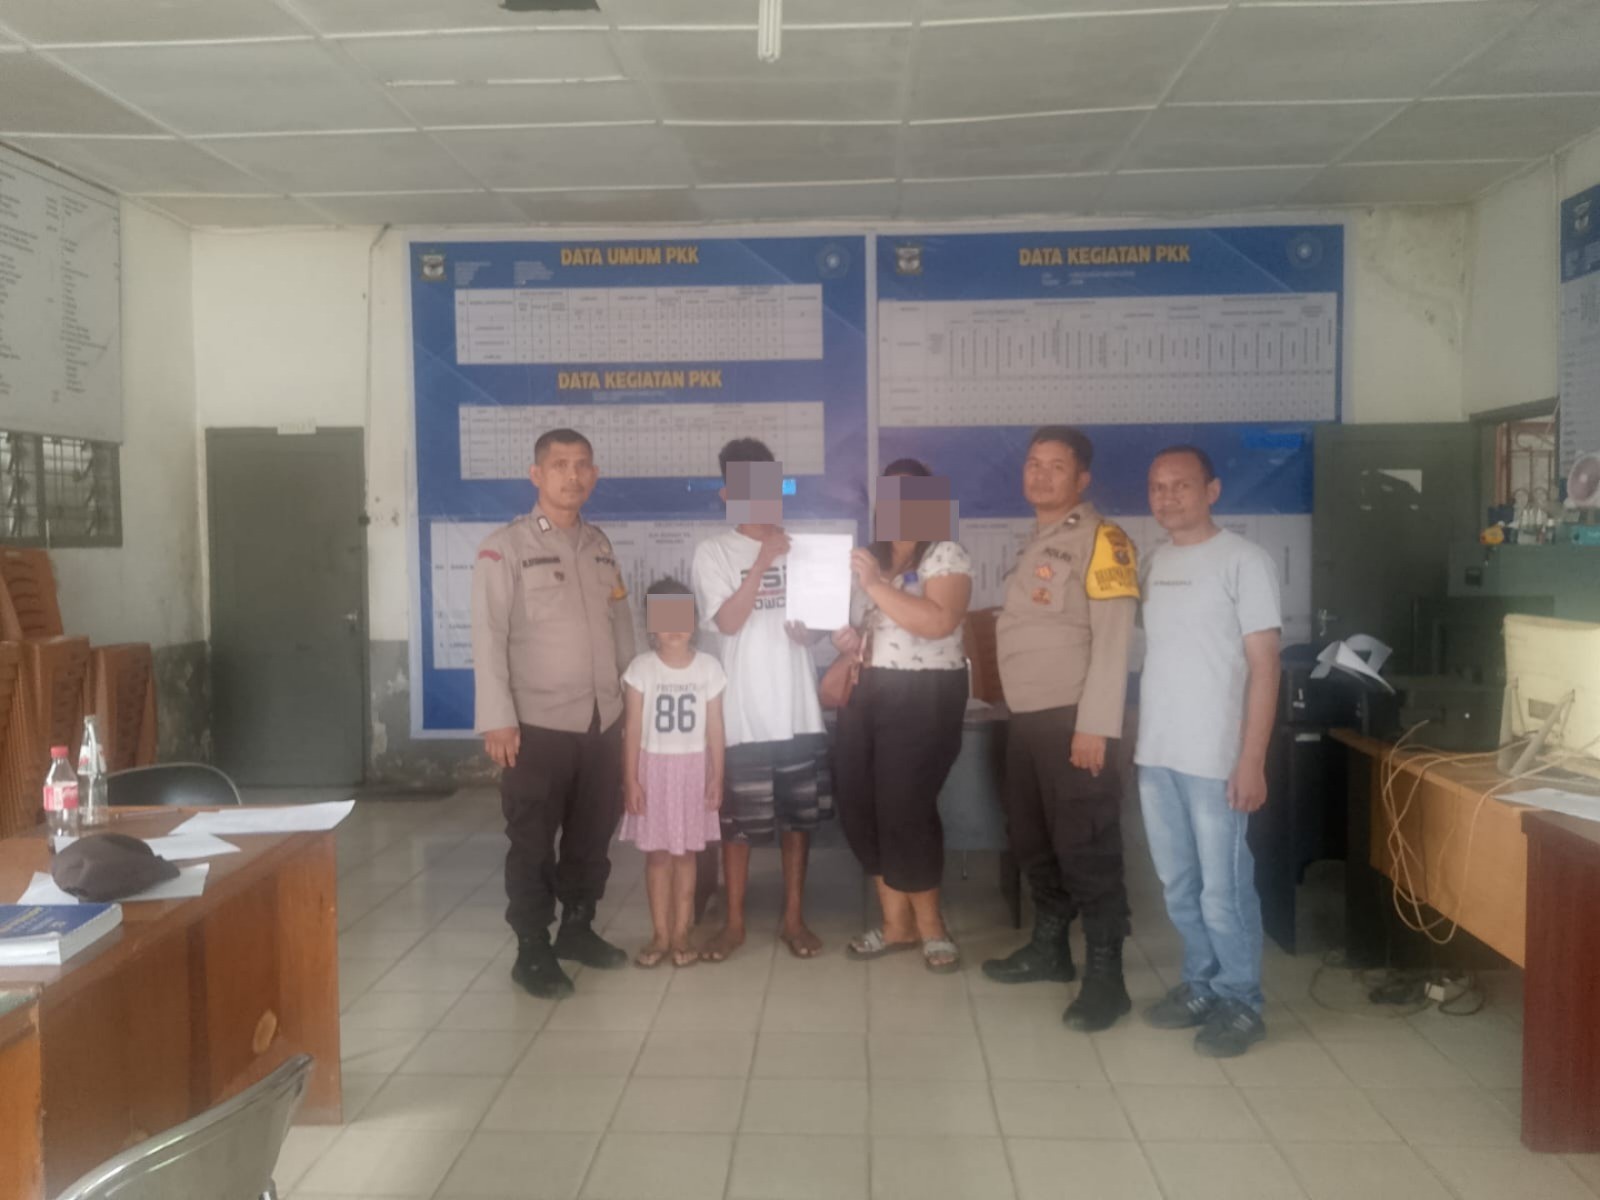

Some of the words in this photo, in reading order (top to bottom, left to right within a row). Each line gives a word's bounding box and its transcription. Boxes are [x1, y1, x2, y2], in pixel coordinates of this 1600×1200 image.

[560, 248, 603, 267] DATA
[607, 246, 661, 266] UMUM
[665, 245, 698, 264] PKK
[1019, 248, 1062, 266] DATA
[1067, 246, 1151, 265] KEGIATAN
[1156, 245, 1191, 263] PKK
[559, 372, 600, 390] DATA
[605, 371, 684, 389] KEGIATAN
[689, 370, 722, 388] PKK
[655, 693, 697, 733] 86
